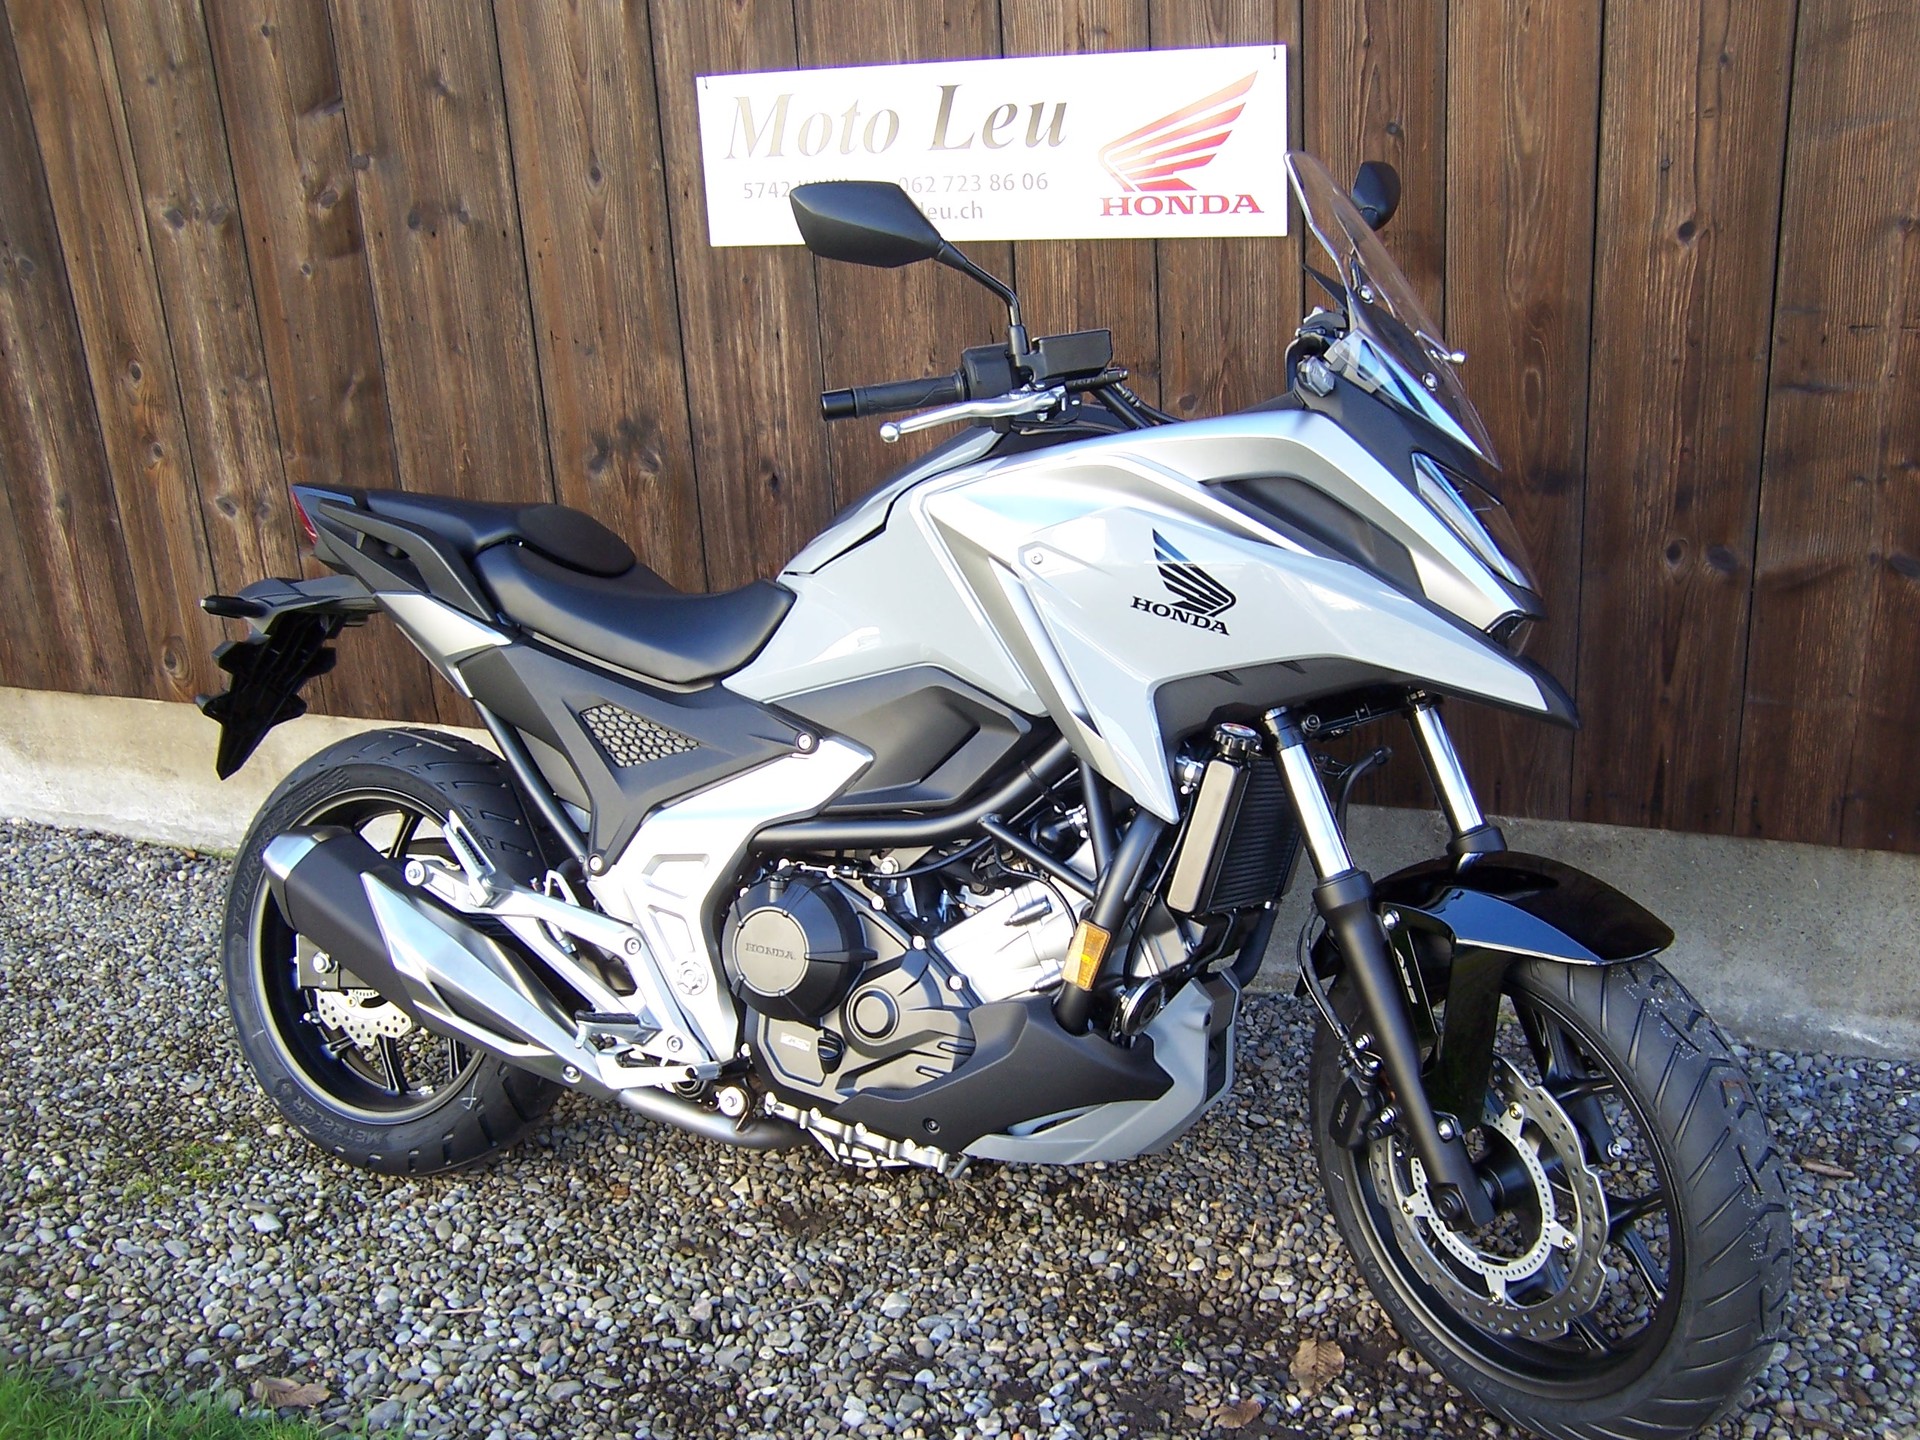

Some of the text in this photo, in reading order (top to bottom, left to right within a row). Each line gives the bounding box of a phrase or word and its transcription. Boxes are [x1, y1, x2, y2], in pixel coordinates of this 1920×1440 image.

[725, 84, 1068, 160] Moto Leu
[743, 181, 790, 199] 5742
[899, 176, 936, 193] 062
[943, 174, 981, 192] 723
[990, 173, 1015, 191] 86
[1022, 172, 1048, 190] 06
[920, 200, 983, 220] leu.ch
[1099, 193, 1265, 217] HONDA
[1130, 596, 1230, 636] HONDA
[744, 942, 794, 960] HONDA
[293, 1096, 388, 1144] METZELER
